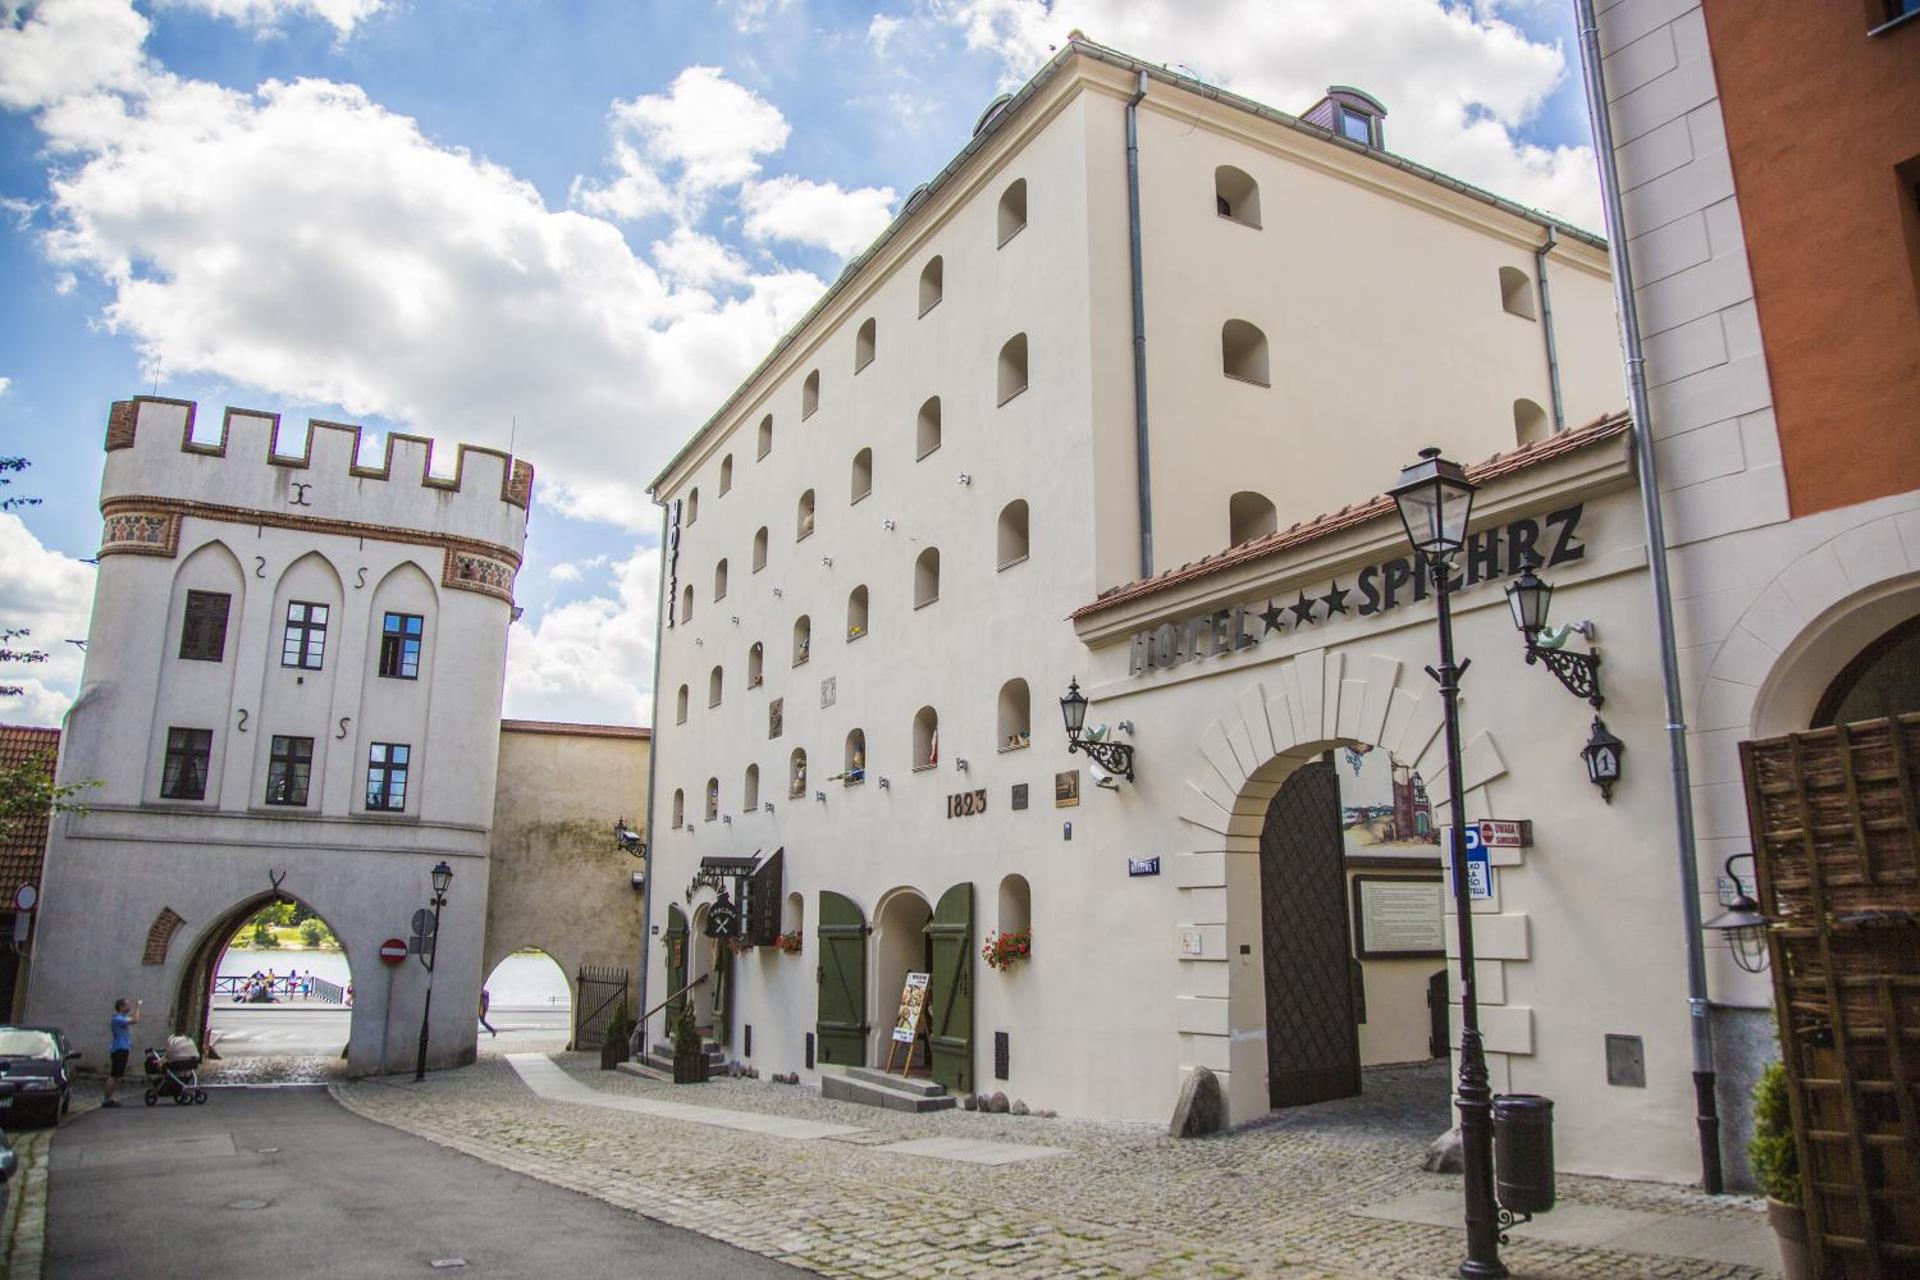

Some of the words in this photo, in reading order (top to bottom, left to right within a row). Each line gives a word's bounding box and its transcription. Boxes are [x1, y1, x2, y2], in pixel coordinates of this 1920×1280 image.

[1128, 603, 1255, 677] HOTEL
[1601, 754, 1609, 771] 1
[946, 788, 987, 819] 1823
